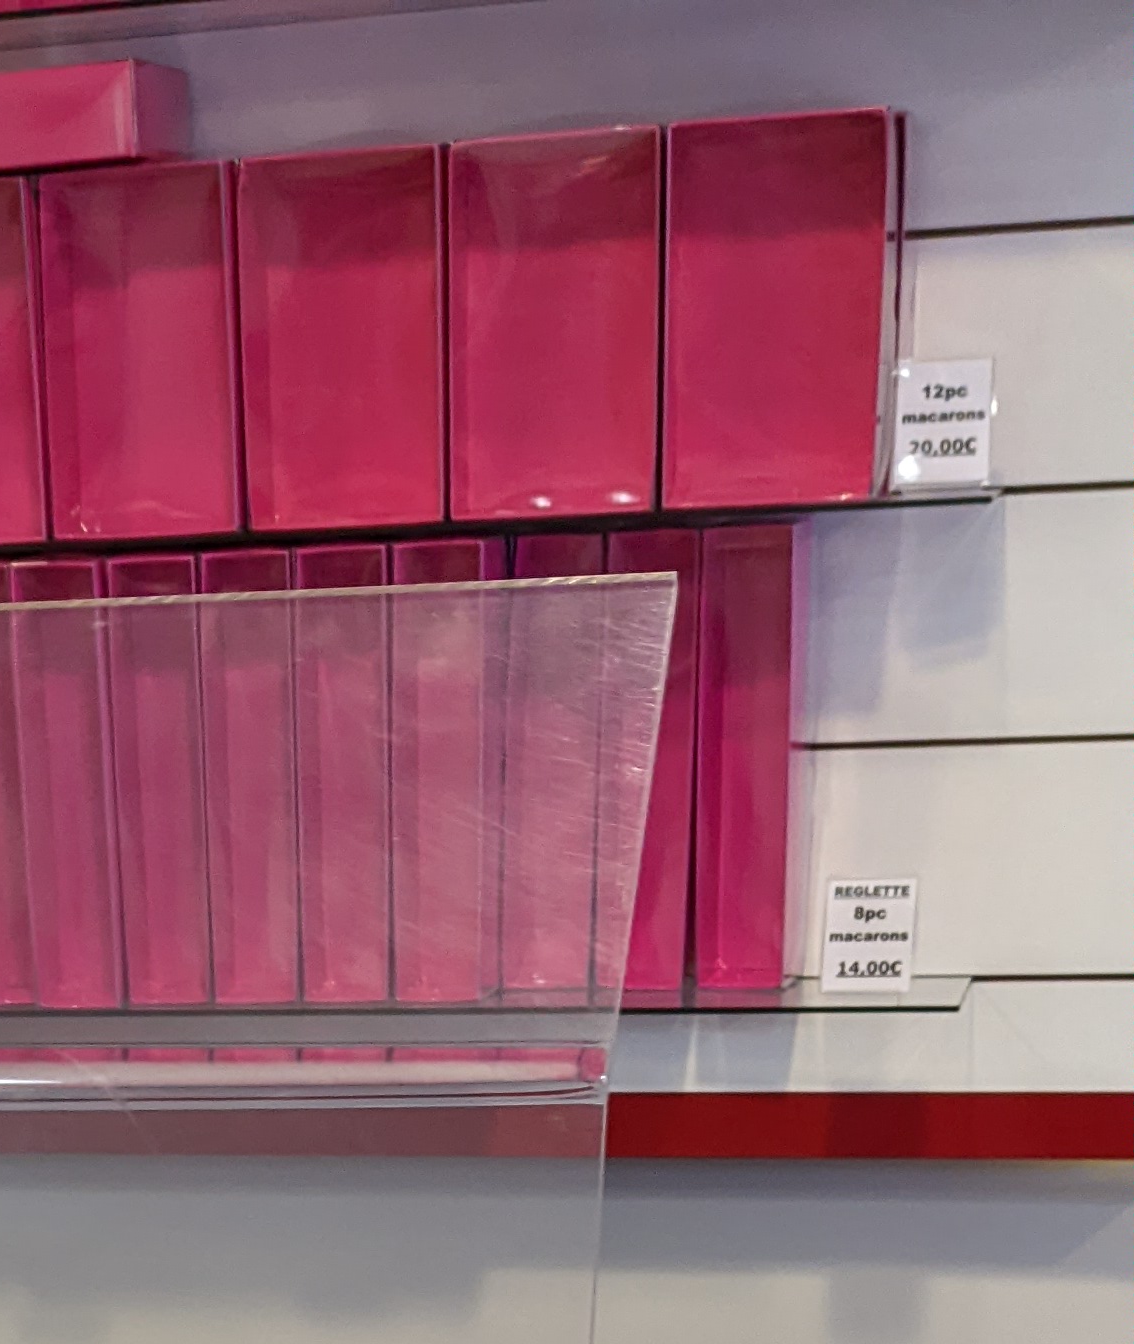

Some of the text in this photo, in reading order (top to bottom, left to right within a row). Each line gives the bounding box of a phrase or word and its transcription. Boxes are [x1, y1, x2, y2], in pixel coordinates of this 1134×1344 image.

[923, 384, 968, 402] 12pc
[902, 410, 986, 425] macarons
[829, 931, 909, 942] macarons
